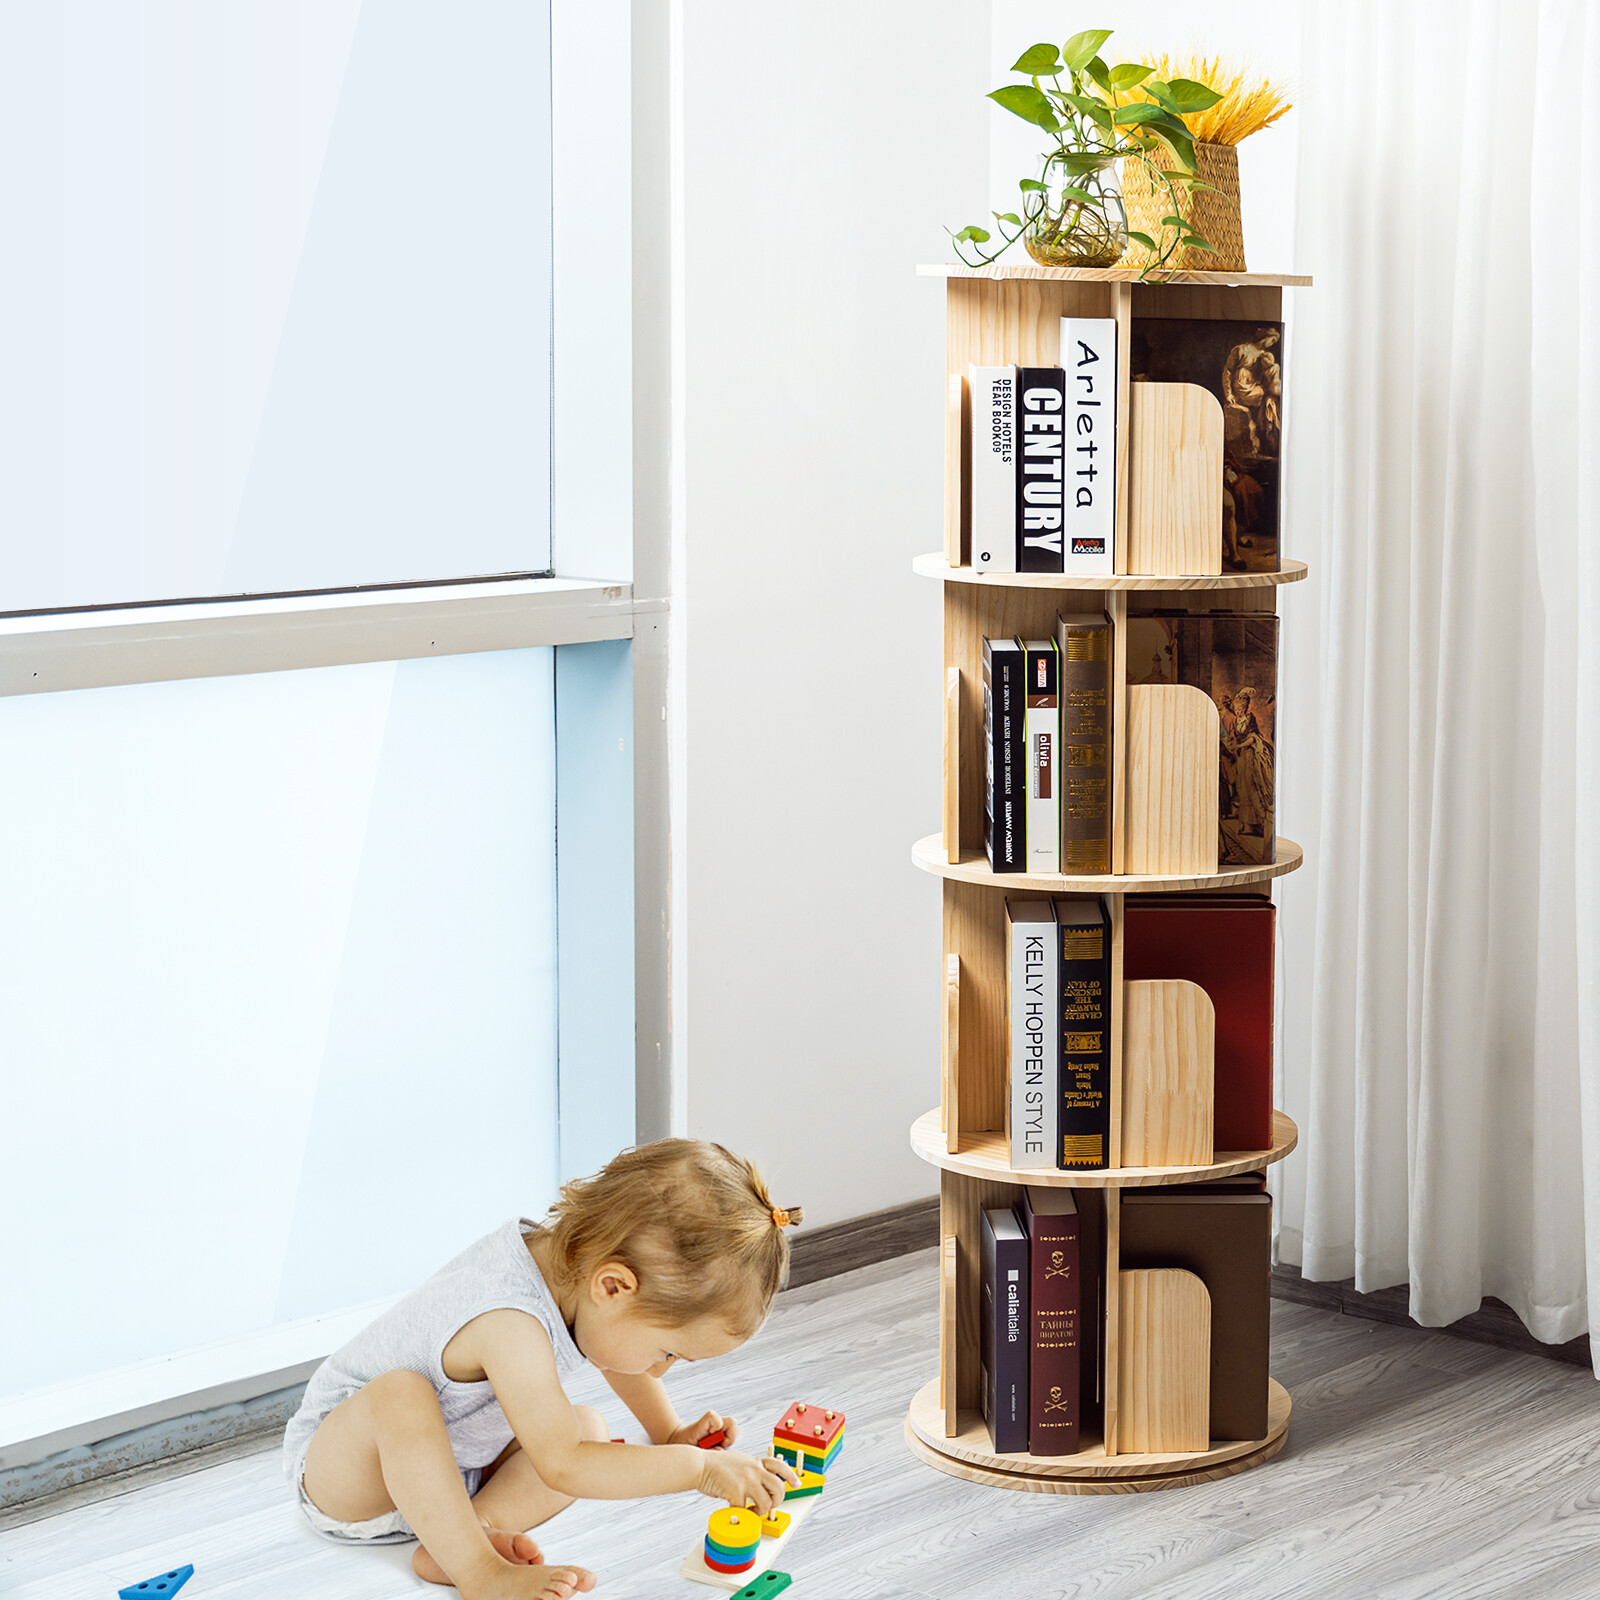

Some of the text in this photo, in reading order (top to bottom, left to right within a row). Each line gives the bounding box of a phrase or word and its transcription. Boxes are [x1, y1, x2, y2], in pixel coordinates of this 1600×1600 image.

[992, 379, 1001, 453] YEAR BOOK09
[1002, 379, 1012, 463] DESIGN HOTELS
[1076, 340, 1101, 508] Arletta
[1023, 387, 1062, 554] CENTURY
[1040, 736, 1050, 767] olivia
[1064, 988, 1102, 996] DESCENT
[1025, 936, 1043, 1153] KELLY HOPPEN STYLE
[1008, 1284, 1019, 1342] caliaitalia
[1040, 1320, 1073, 1329] ТАЙНЫ
